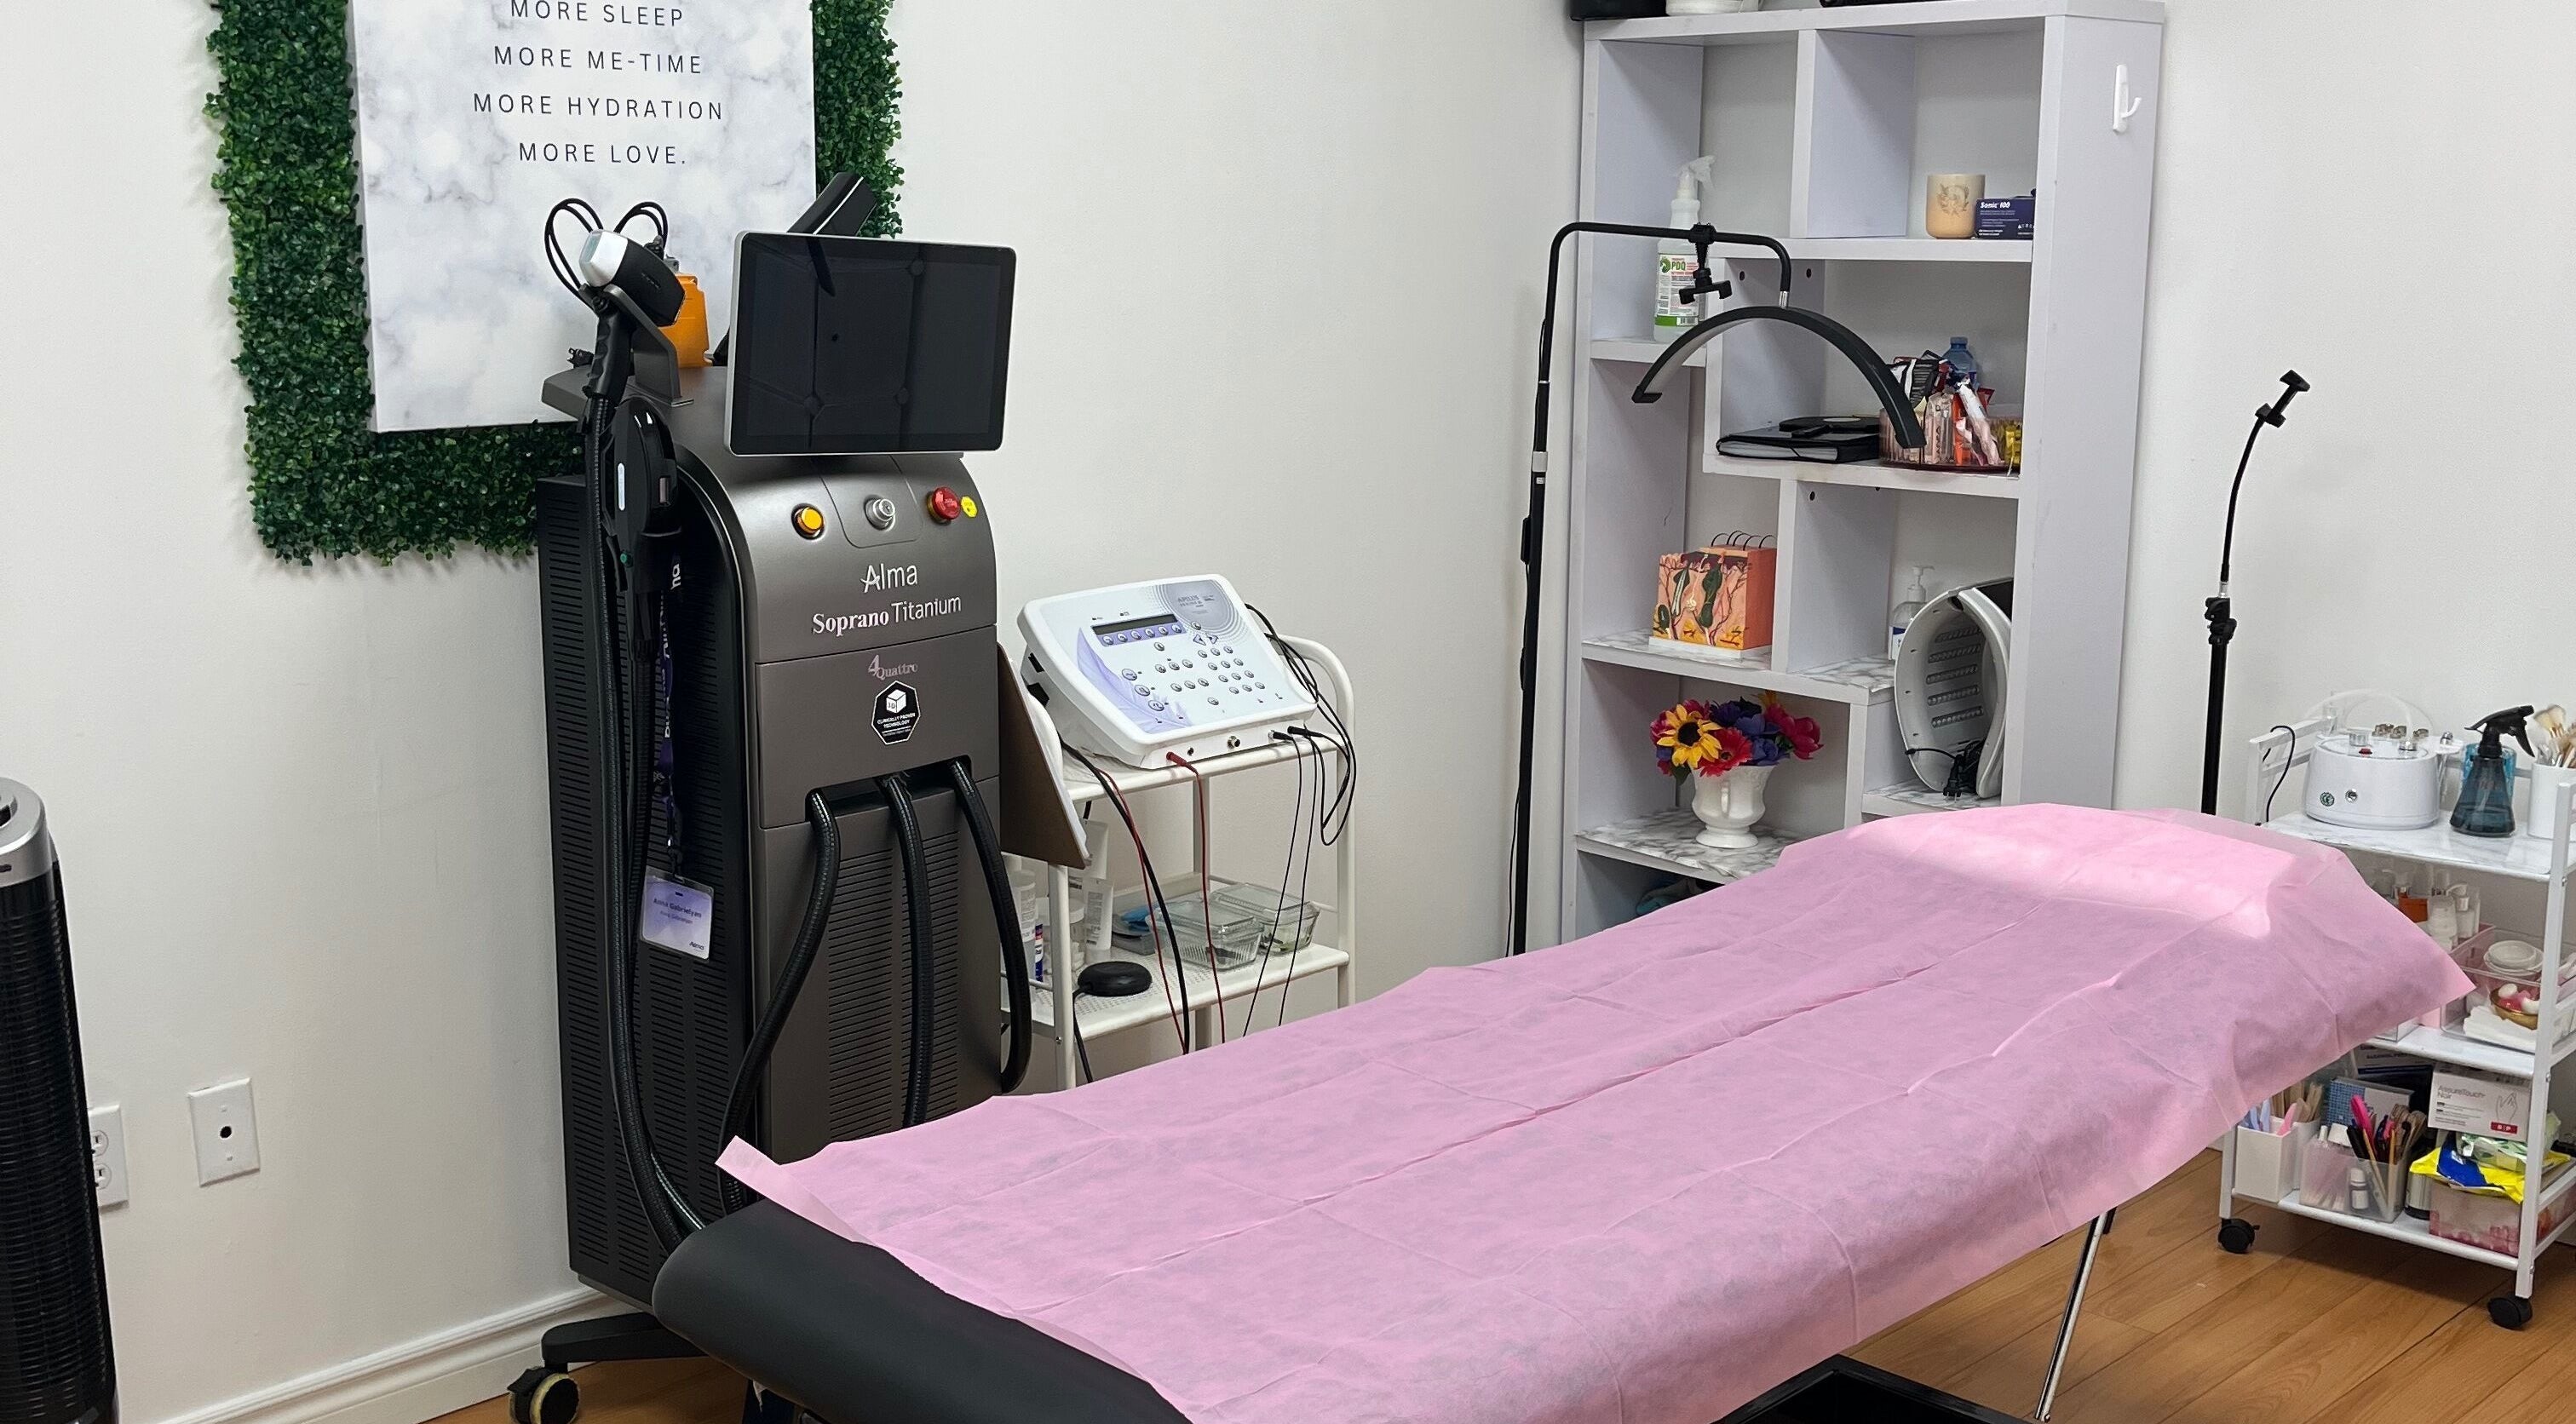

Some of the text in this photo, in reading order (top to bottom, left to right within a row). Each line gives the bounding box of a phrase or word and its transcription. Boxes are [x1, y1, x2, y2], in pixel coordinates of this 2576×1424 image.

[511, 0, 682, 26] MORE SLEEP
[494, 45, 701, 74] MORE ME-TIME
[474, 93, 722, 121] MORE HYDRATION
[520, 142, 686, 164] MORE LOVE.
[1672, 261, 1686, 271] PDQ
[860, 563, 918, 594] Alma
[812, 595, 962, 637] Soprano Titanium
